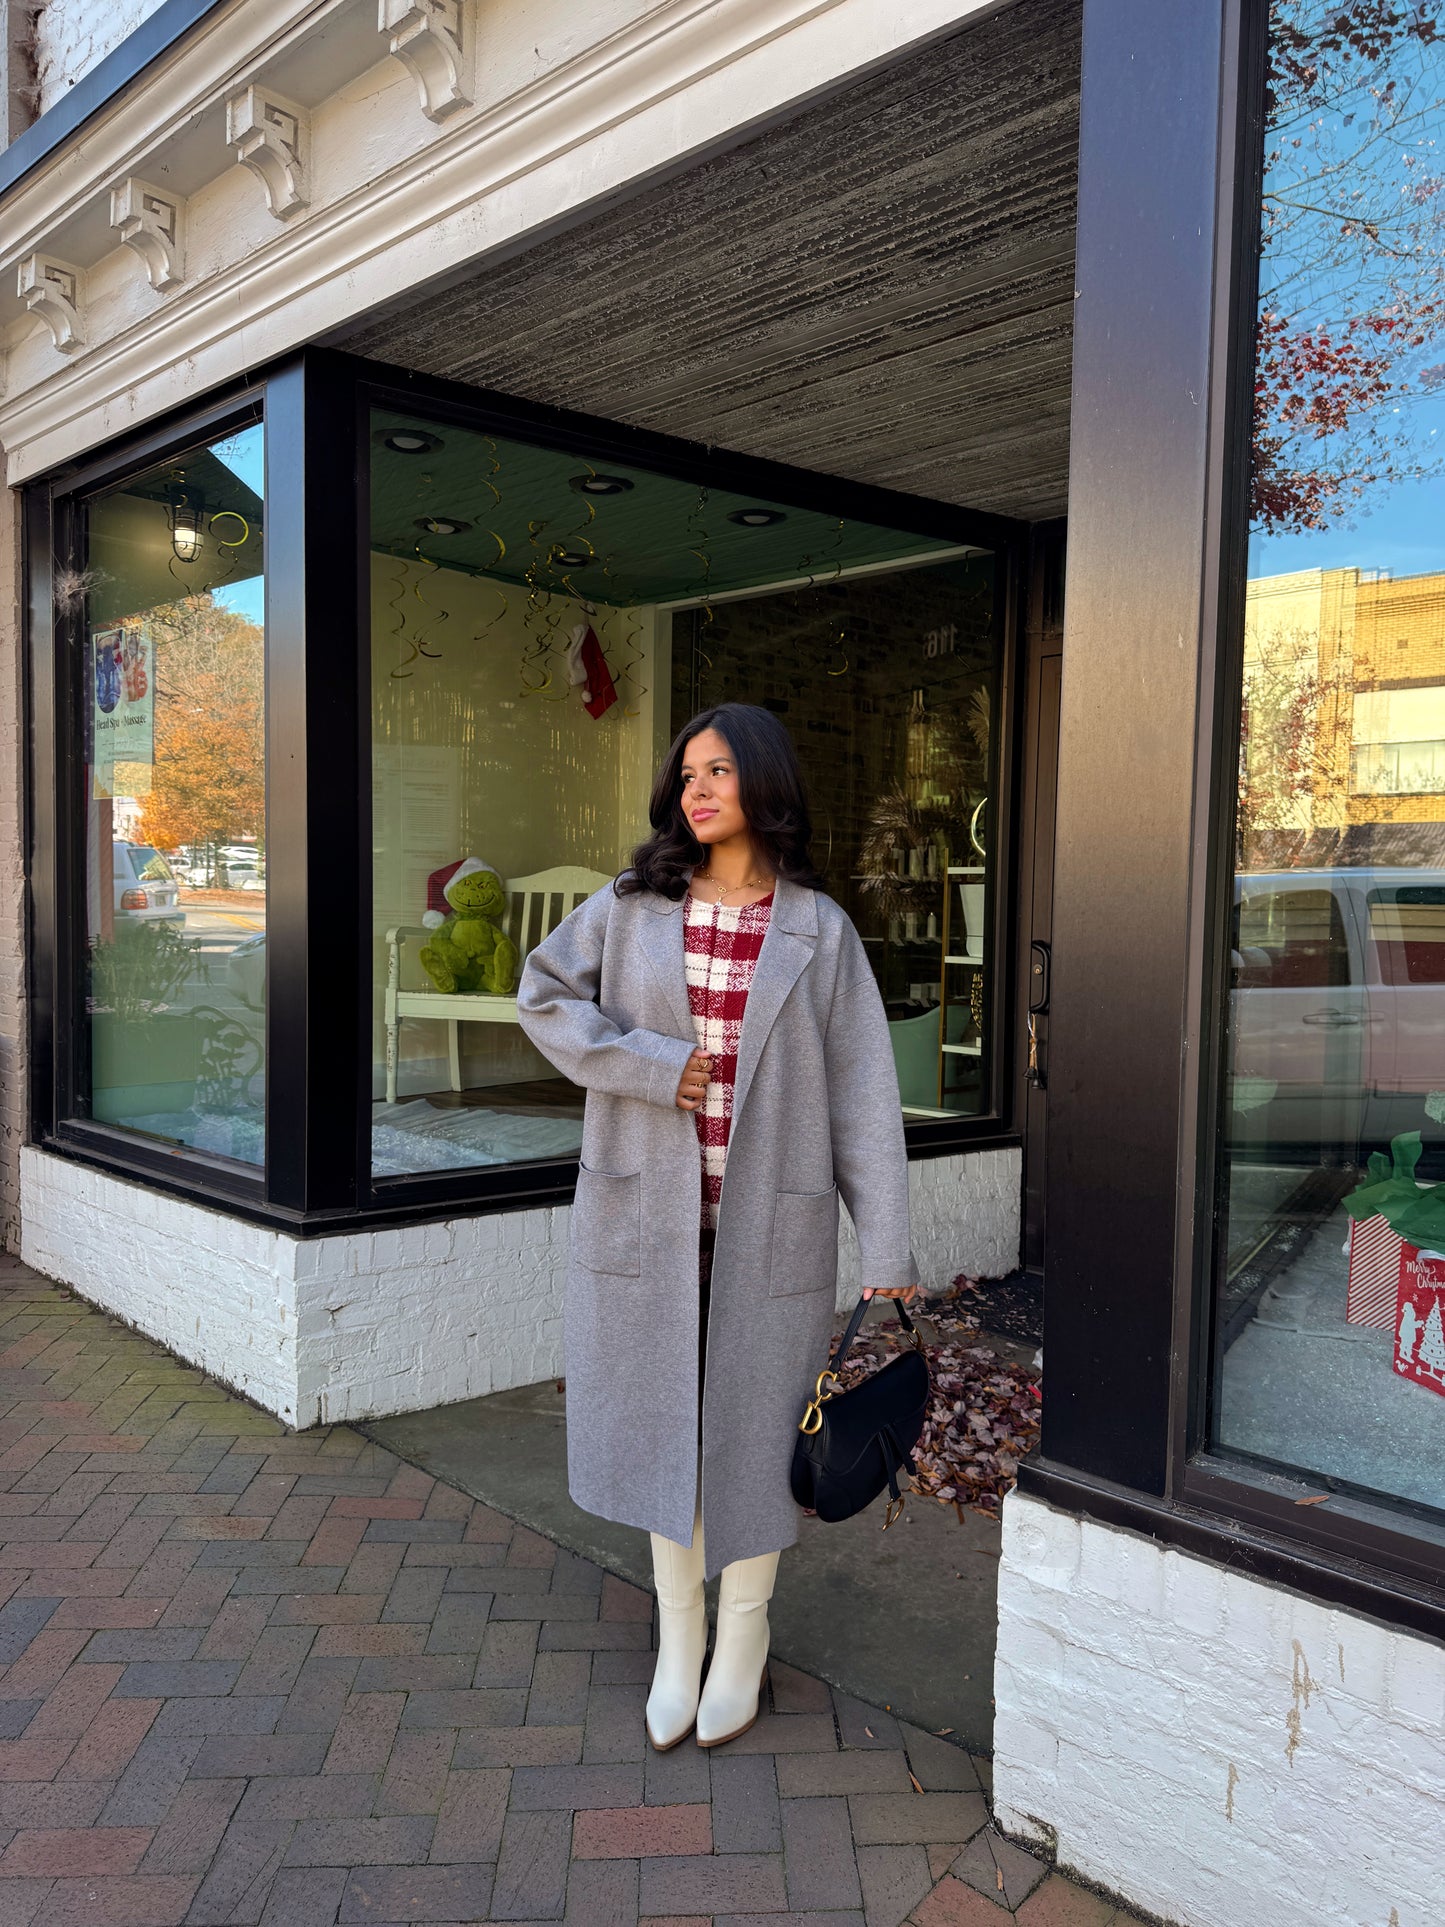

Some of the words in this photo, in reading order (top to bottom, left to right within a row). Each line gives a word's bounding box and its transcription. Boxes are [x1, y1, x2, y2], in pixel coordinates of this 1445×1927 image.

[110, 718, 120, 731] Spa
[124, 715, 147, 727] Massage
[1405, 1260, 1436, 1274] Merry
